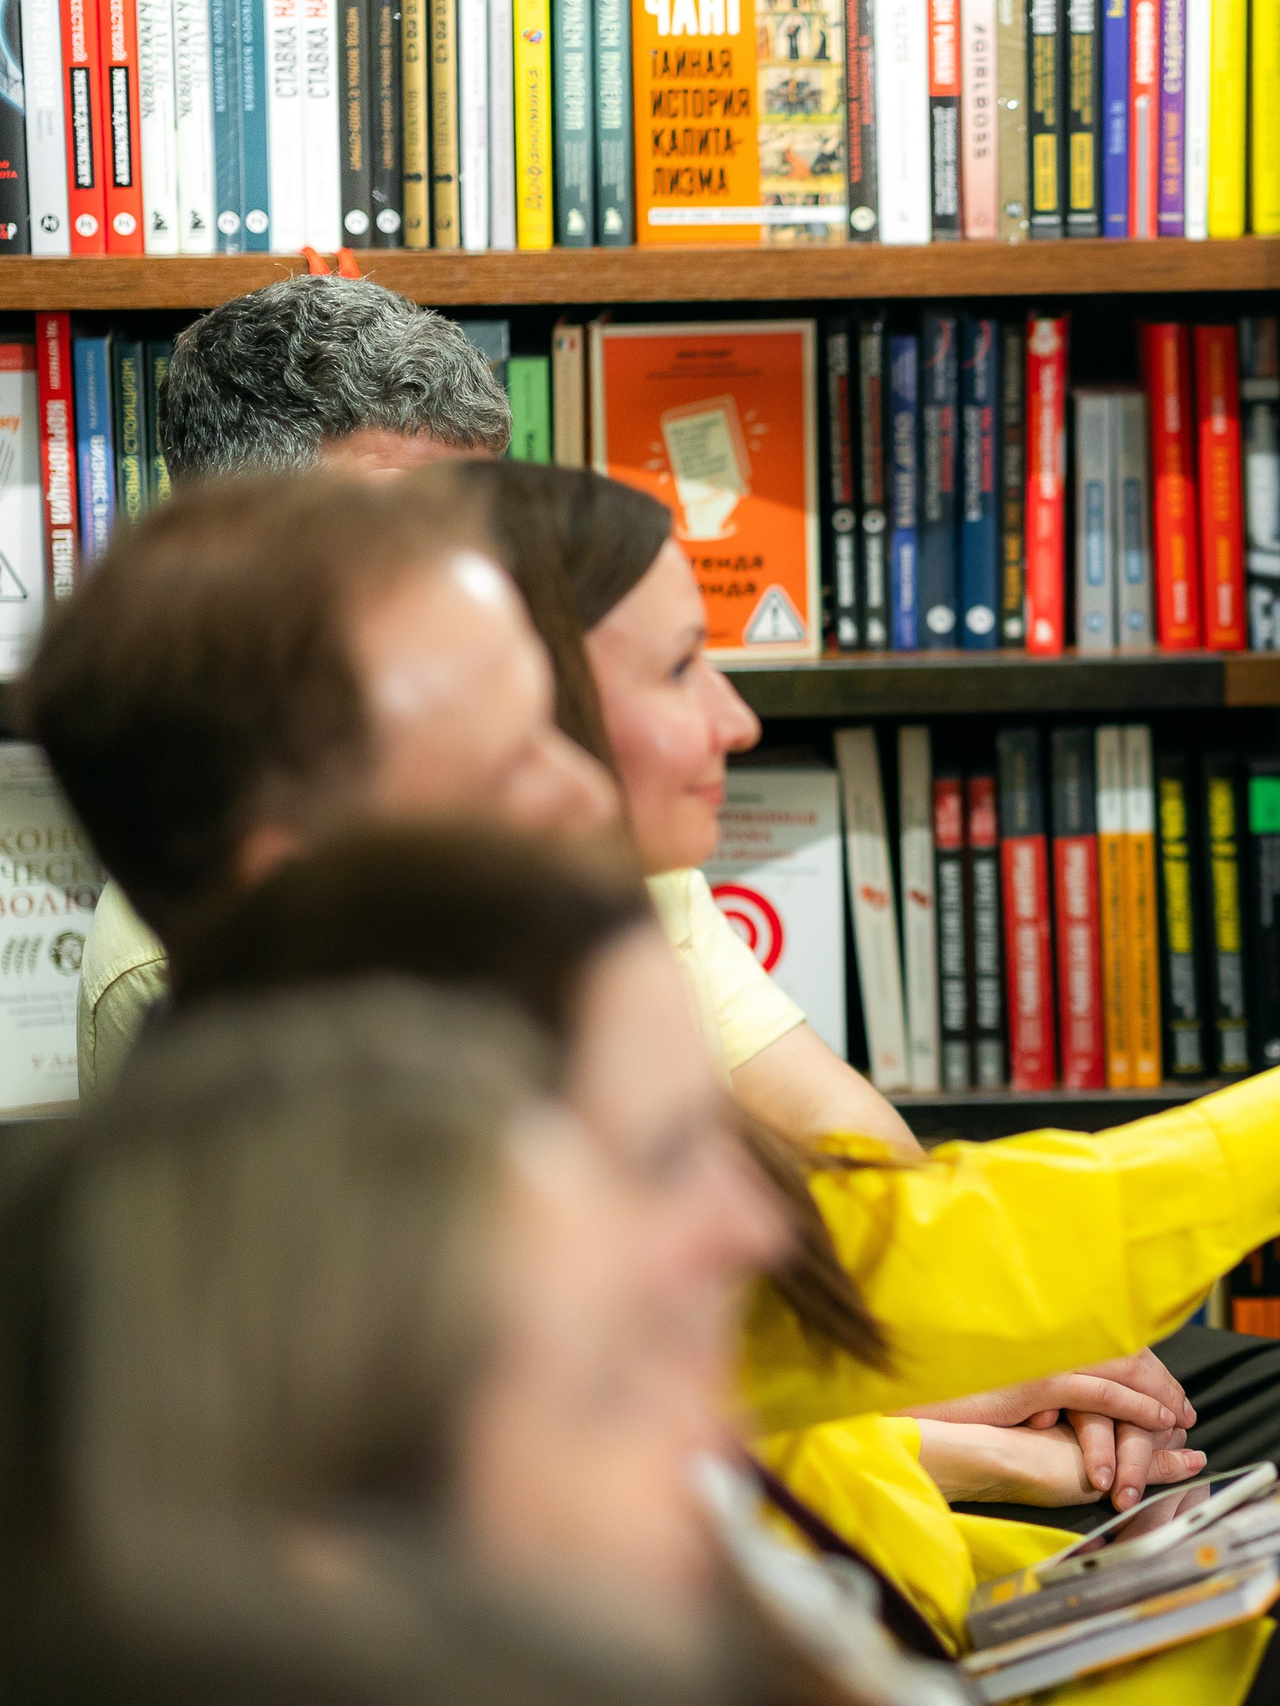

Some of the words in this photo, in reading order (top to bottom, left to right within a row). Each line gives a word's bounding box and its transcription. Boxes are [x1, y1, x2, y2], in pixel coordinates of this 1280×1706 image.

[275, 26, 298, 99] СТАВКА
[307, 26, 330, 99] СТАВКА
[651, 47, 733, 79] ТАЙНАЯ
[972, 24, 991, 160] #GIRLBOSS
[73, 68, 92, 187] МЕНЕДЖМЕНТ
[111, 68, 130, 186] МЕНЕДЖМЕНТ
[651, 88, 750, 119] ИСТОРИЯ
[651, 127, 743, 158] КАПИТА-
[653, 167, 729, 197] ЛИЗМА
[121, 357, 140, 454] СТОИЦИЗМ
[46, 399, 72, 525] КОРПОРАЦИЯ
